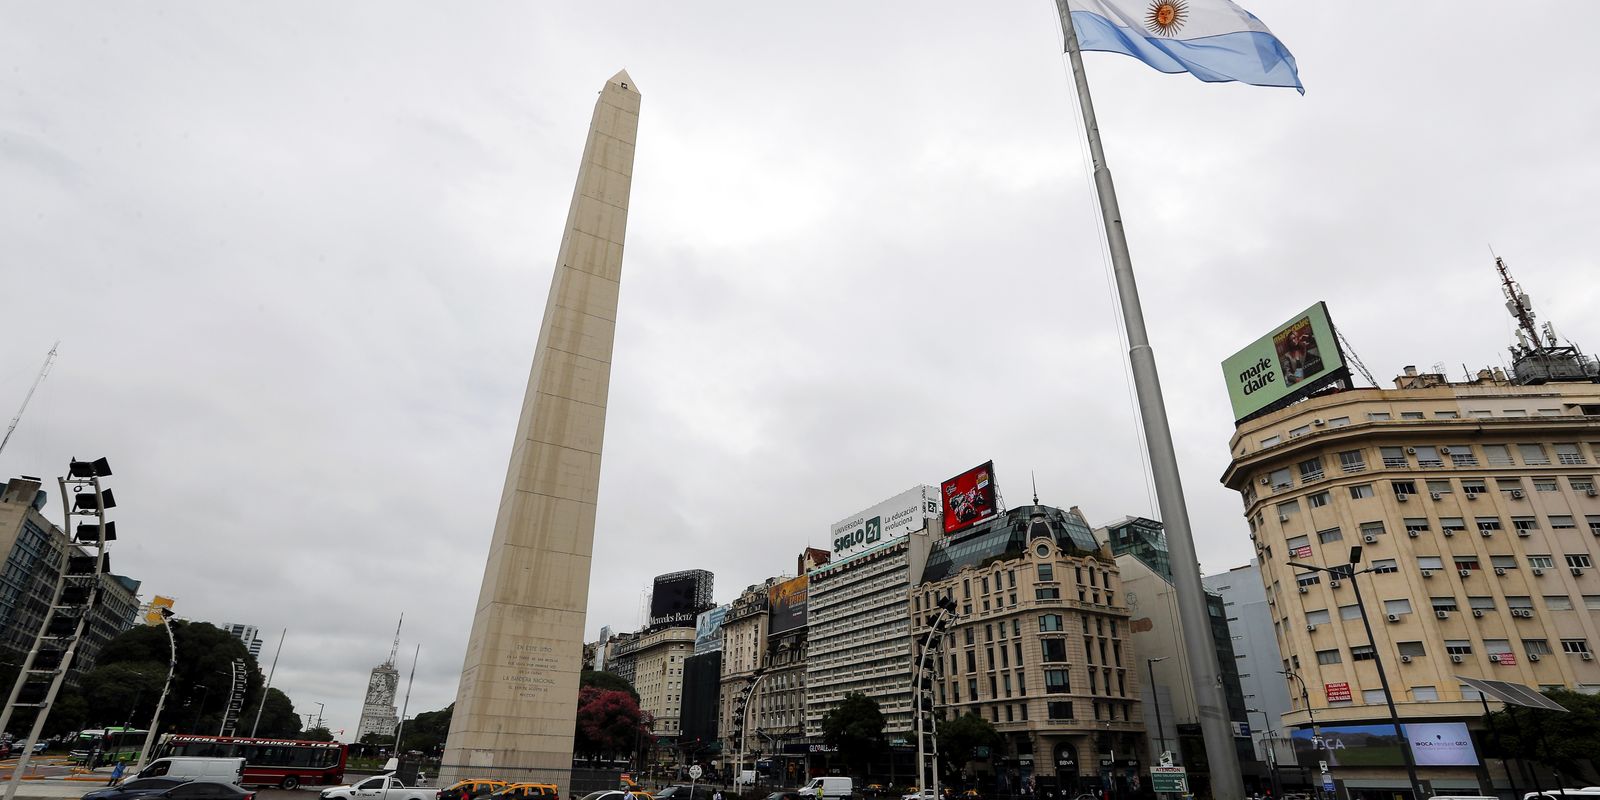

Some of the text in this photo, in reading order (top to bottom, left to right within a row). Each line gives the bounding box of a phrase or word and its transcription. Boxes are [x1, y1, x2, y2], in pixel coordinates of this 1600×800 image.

[1239, 357, 1271, 383] marie
[1243, 370, 1276, 396] claire
[884, 505, 918, 524] La educación
[929, 504, 937, 513] 21
[834, 518, 864, 535] UNIVERSIDAD
[884, 516, 913, 531] evoluciona
[833, 523, 878, 553] SIGLO 21
[675, 611, 693, 622] Benz
[172, 735, 217, 743] LINIERS
